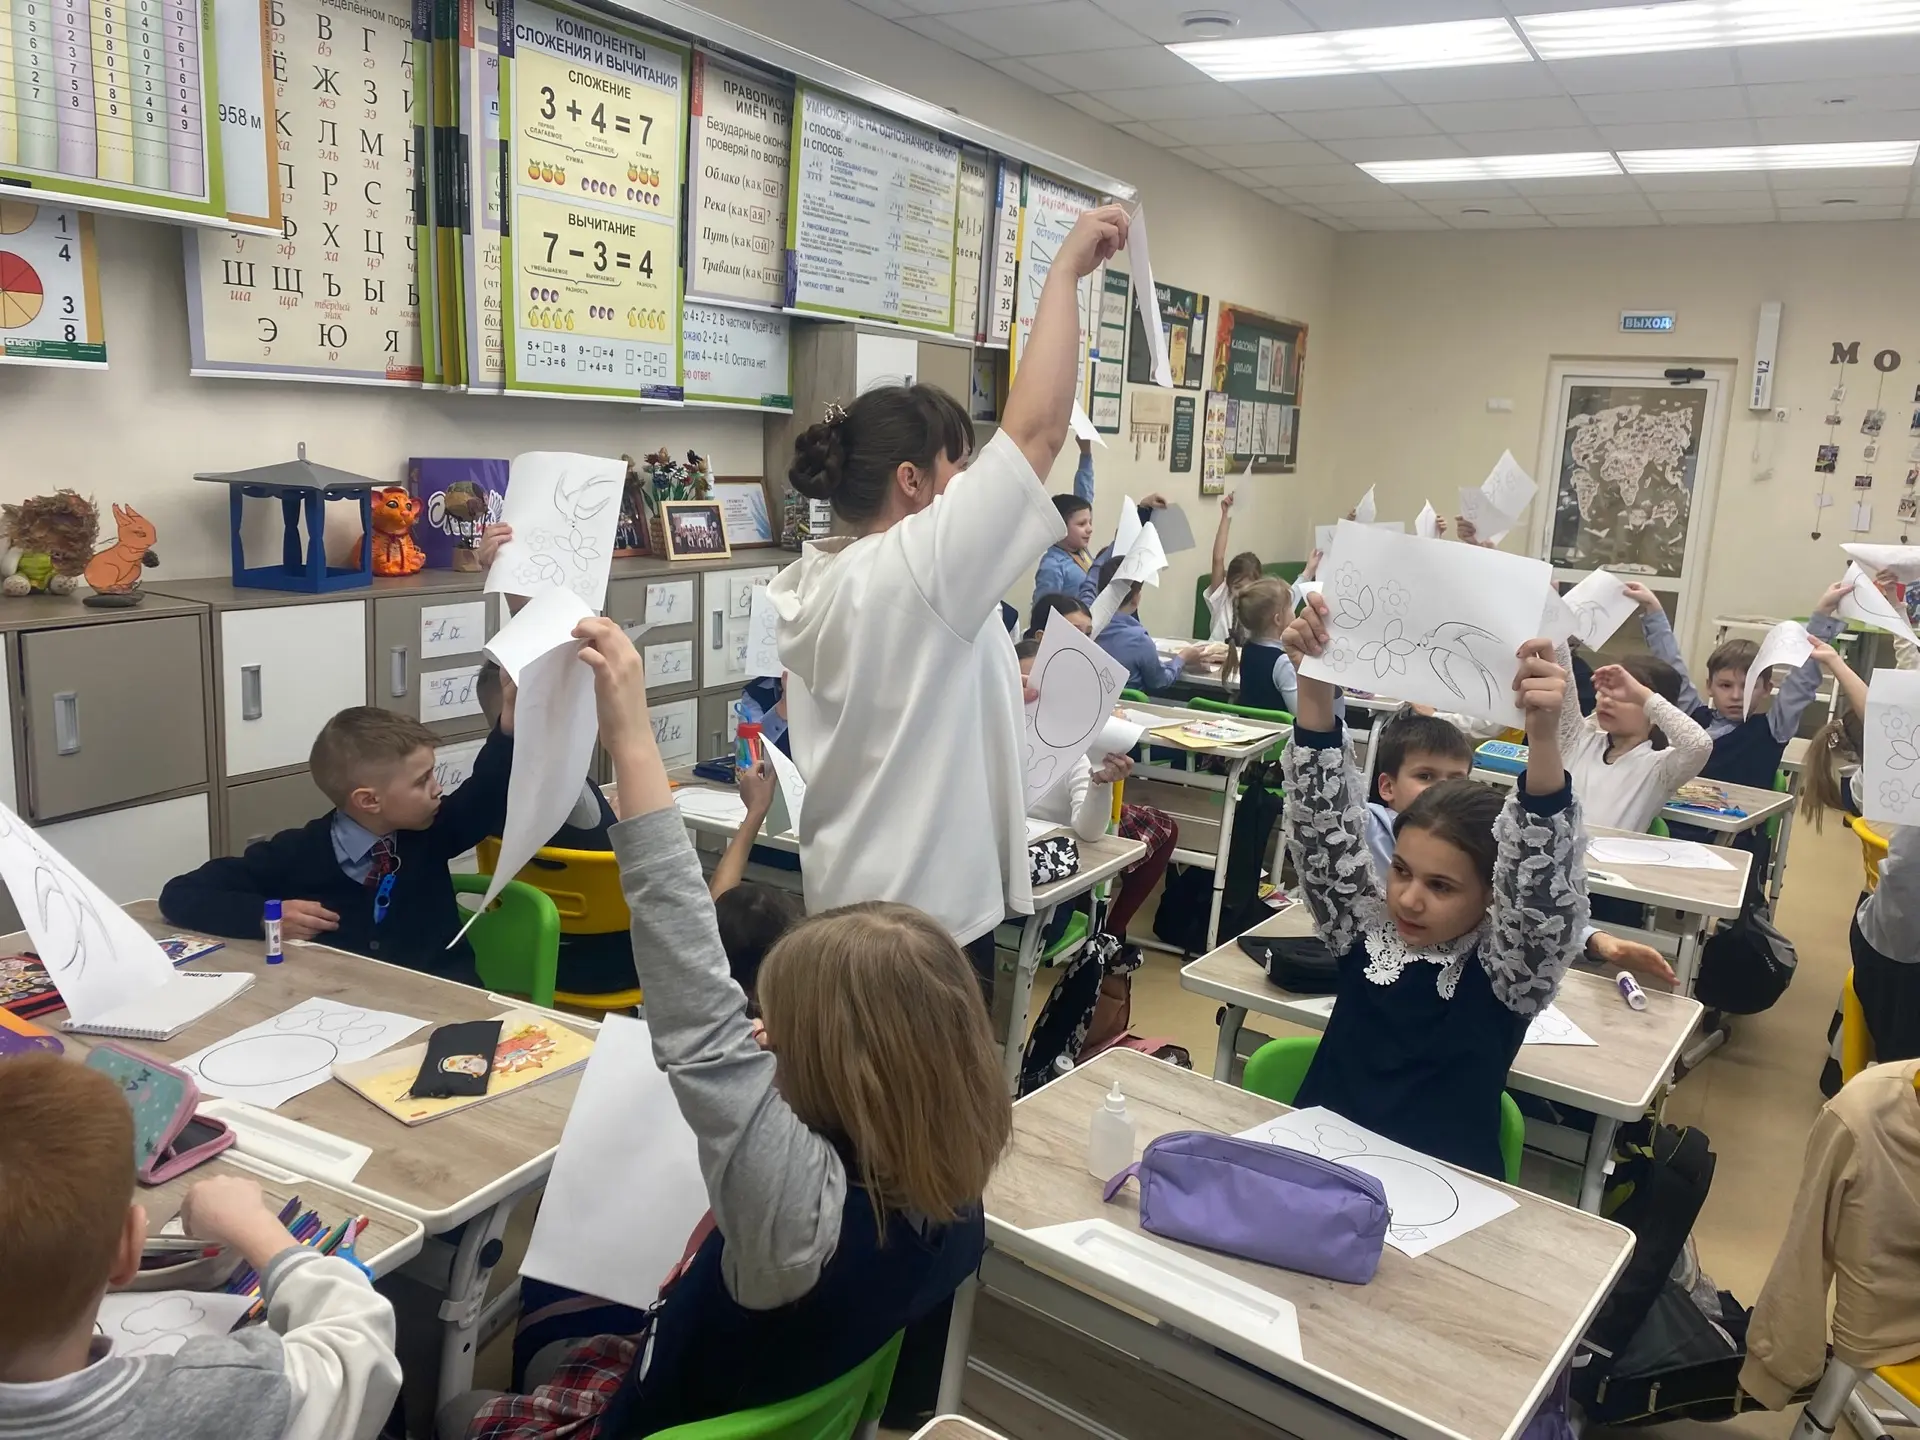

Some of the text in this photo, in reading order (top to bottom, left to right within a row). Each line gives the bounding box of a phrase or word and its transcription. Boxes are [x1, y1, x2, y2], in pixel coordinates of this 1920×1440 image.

[28, 4, 184, 52] 0 0 0 0 6
[105, 8, 183, 36] 6 4 7
[317, 14, 332, 40] В
[362, 28, 376, 53] Г
[556, 18, 645, 61] КОМПОНЕНТЫ
[29, 21, 184, 67] 5 2 8 0 1
[30, 37, 186, 83] 6 3 0 7 6
[318, 42, 375, 68] вэ гэ
[516, 25, 591, 61] СЛОЖЕНИЯ
[595, 52, 603, 65] И
[607, 55, 678, 89] ВЫЧИТАНИЯ
[31, 54, 186, 99] 3 7 1 3 0
[273, 50, 377, 104] Ё Ж З
[569, 70, 631, 99] СЛОЖЕНИЕ
[32, 71, 187, 114] 2 5 8 4 4
[33, 88, 188, 130] 7 8 9 9 9
[318, 98, 336, 109] жэ
[736, 100, 766, 120] ИМЁН
[219, 104, 247, 126] 958
[540, 86, 653, 145] 3 4 7
[318, 119, 384, 156] Л М
[707, 116, 760, 142] Безударные
[805, 100, 864, 129] УМНОЖЕНИЕ
[879, 124, 933, 154] ОДНОЗНАЧНОЕ
[935, 144, 957, 162] ЧИСЛО
[810, 123, 843, 142] СПОСОБ:
[318, 150, 379, 170] эль эм
[706, 137, 790, 168] проверяй по вопро
[812, 142, 845, 158] СПОСОБ:
[705, 166, 740, 184] Облако
[961, 162, 985, 178] БУКВЫ
[322, 171, 381, 204] Р С
[1010, 182, 1017, 192] 21
[1031, 173, 1096, 208] МНОГОУГОЛЬНИКИ
[323, 200, 378, 219] эр эс
[704, 196, 726, 212] Река
[1009, 205, 1017, 217] 26
[58, 214, 66, 232] 1
[569, 213, 636, 237] ВЫЧИТАНИЕ
[323, 223, 384, 258] Х Ц
[703, 227, 729, 244] Путь
[1007, 229, 1015, 241] 26
[59, 244, 71, 262] 4
[277, 242, 338, 262] эф ха
[543, 232, 653, 279] 7 3 4
[1006, 252, 1013, 263] 25
[703, 257, 740, 274] Травами
[222, 259, 384, 303] Ш Щ Ъ Ы
[1004, 275, 1012, 286] 30
[62, 296, 74, 313] 3
[231, 289, 251, 302] ша
[280, 294, 298, 309] ща
[1001, 299, 1010, 309] 35
[65, 324, 76, 342] 8
[727, 319, 768, 333] частном будет
[1000, 321, 1008, 331] 35
[1625, 318, 1672, 328] ВЫХОД
[258, 318, 399, 352] Э Ю Я
[527, 341, 566, 353] 5 8
[579, 346, 613, 357] 9 4
[1831, 342, 1901, 372] М О
[547, 358, 566, 367] 3 6
[732, 353, 755, 367] Остатка
[430, 620, 446, 642] А
[450, 627, 460, 639] а
[440, 678, 458, 705] Б
